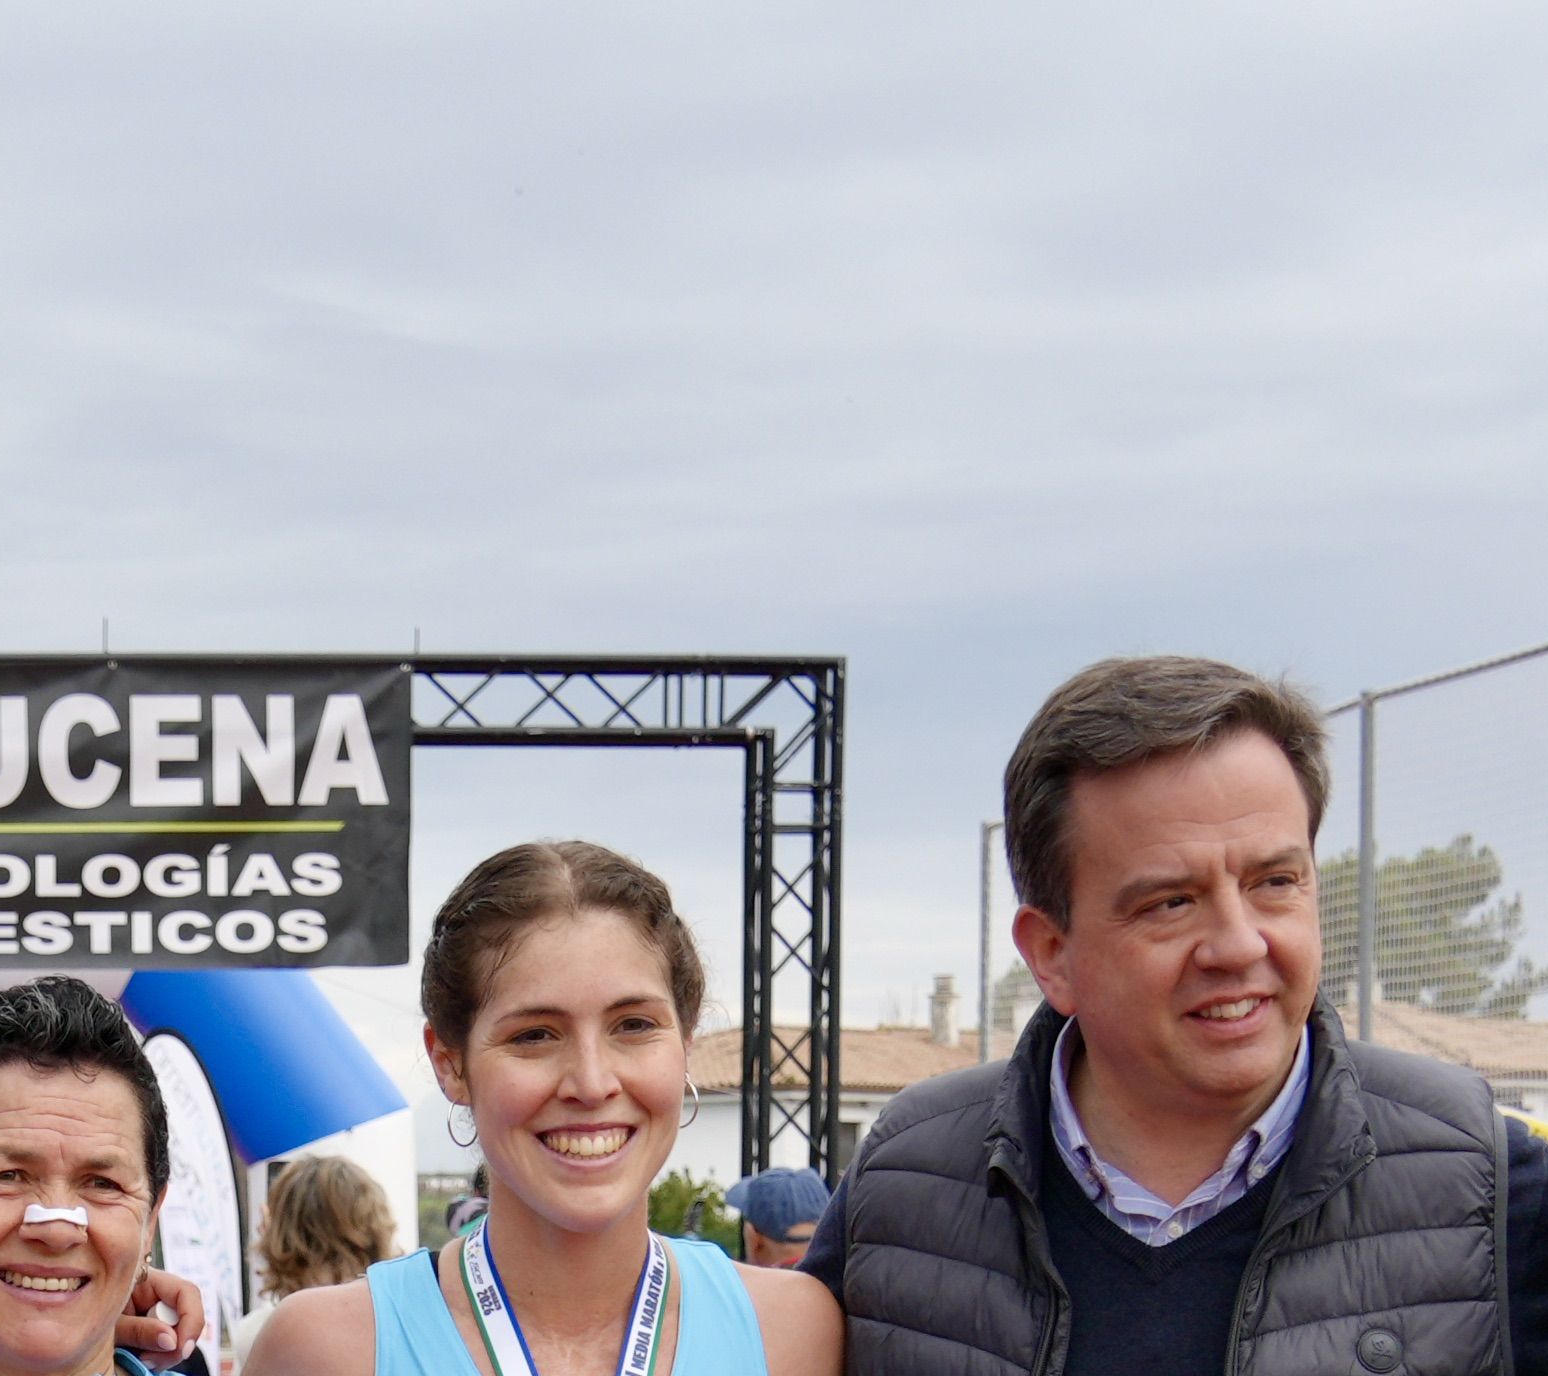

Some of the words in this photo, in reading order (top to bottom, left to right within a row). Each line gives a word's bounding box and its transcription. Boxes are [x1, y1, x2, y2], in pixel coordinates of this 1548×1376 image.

[476, 1289, 495, 1316] 2026
[639, 1265, 664, 1330] MARATÓN
[630, 1332, 651, 1371] MEDIA
